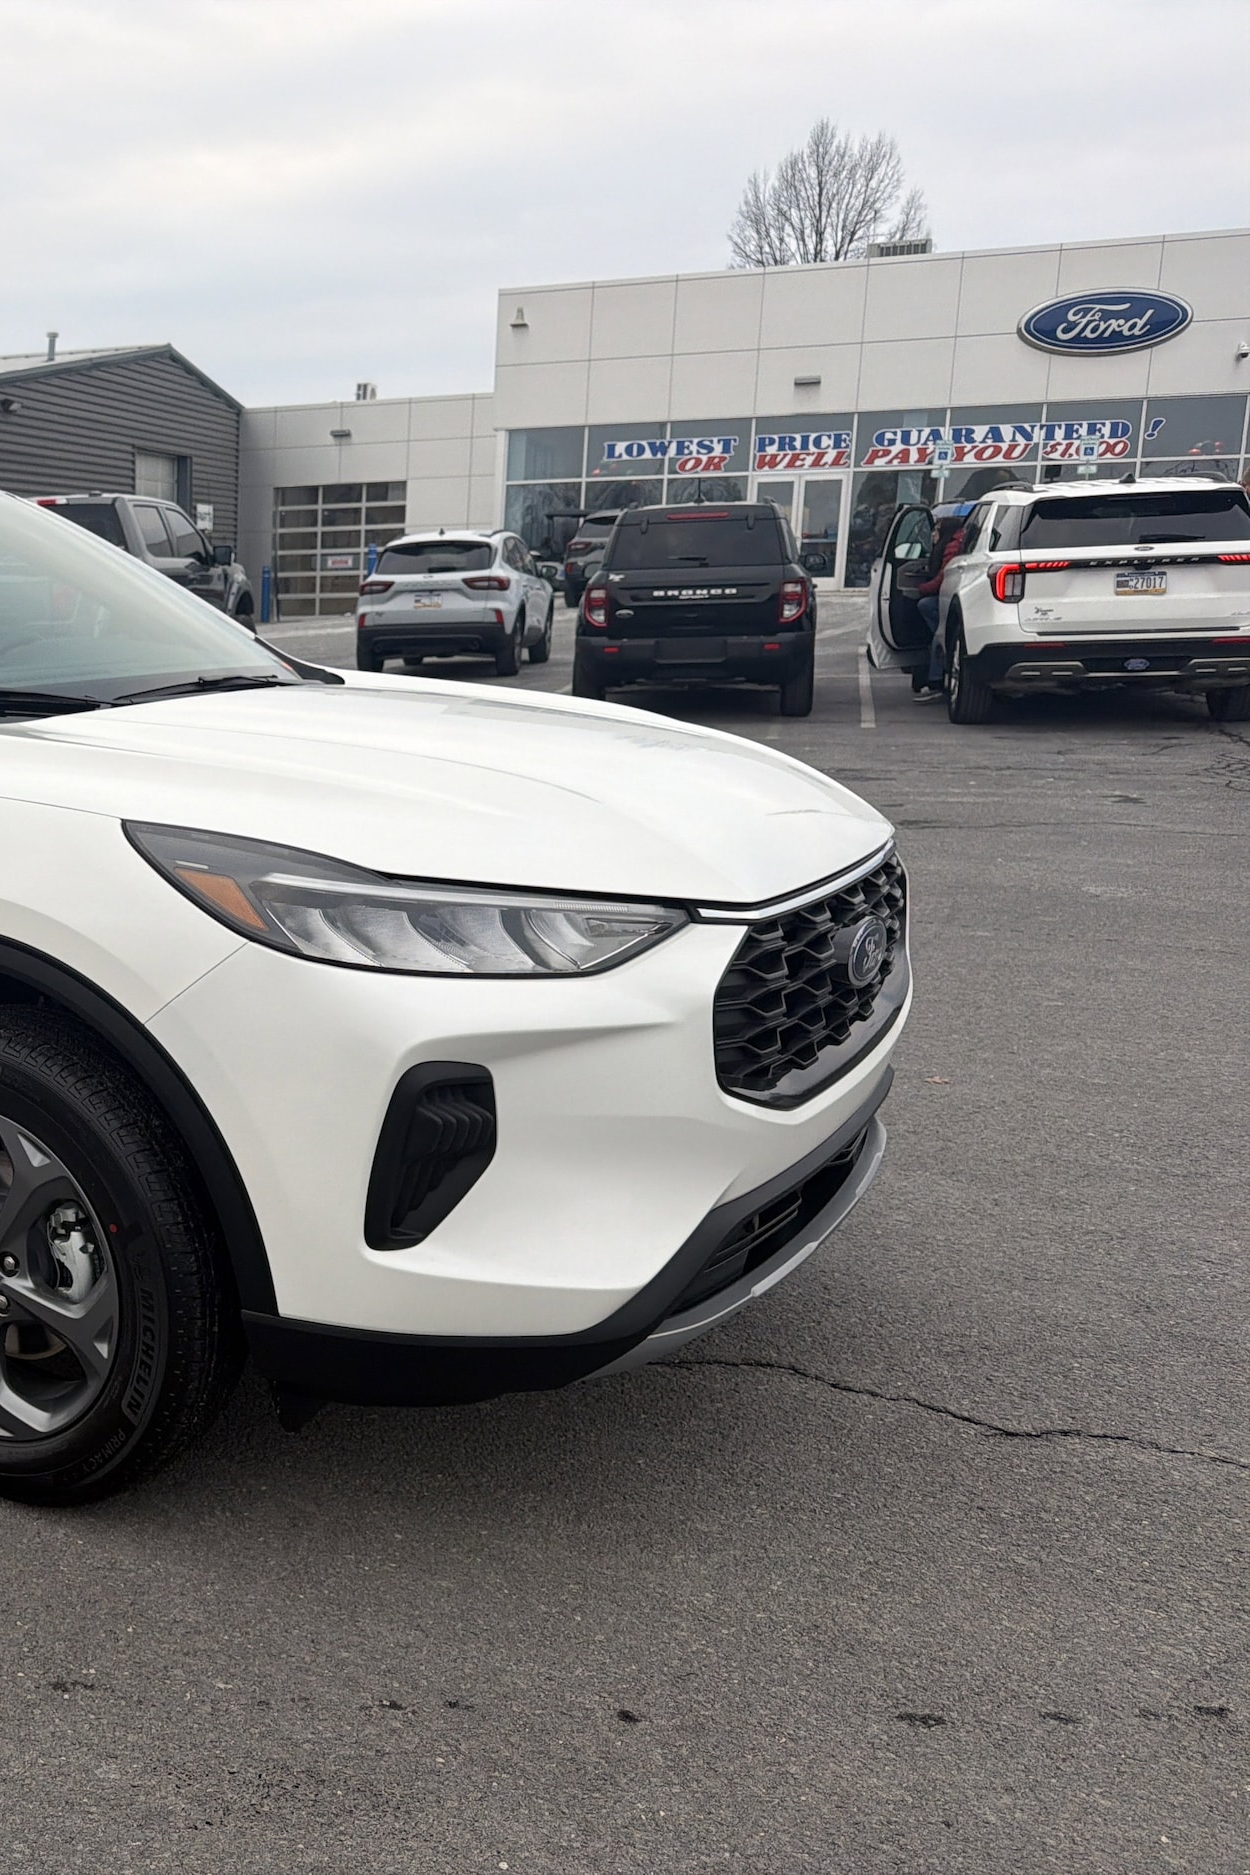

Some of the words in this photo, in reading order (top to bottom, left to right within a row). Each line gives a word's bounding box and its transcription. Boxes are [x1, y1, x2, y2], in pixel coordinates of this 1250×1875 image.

[1056, 303, 1154, 341] Ford
[605, 438, 738, 460] LOWEST
[756, 432, 851, 453] PRICE
[874, 421, 1131, 447] GUARANTEED
[677, 455, 729, 472] OR
[862, 446, 936, 466] PAY
[952, 443, 1032, 463] YOU
[1089, 557, 1200, 566] EXPLORER
[652, 588, 738, 597] BRONCO
[1134, 576, 1164, 590] 27017
[127, 1287, 155, 1417] MICHELIN
